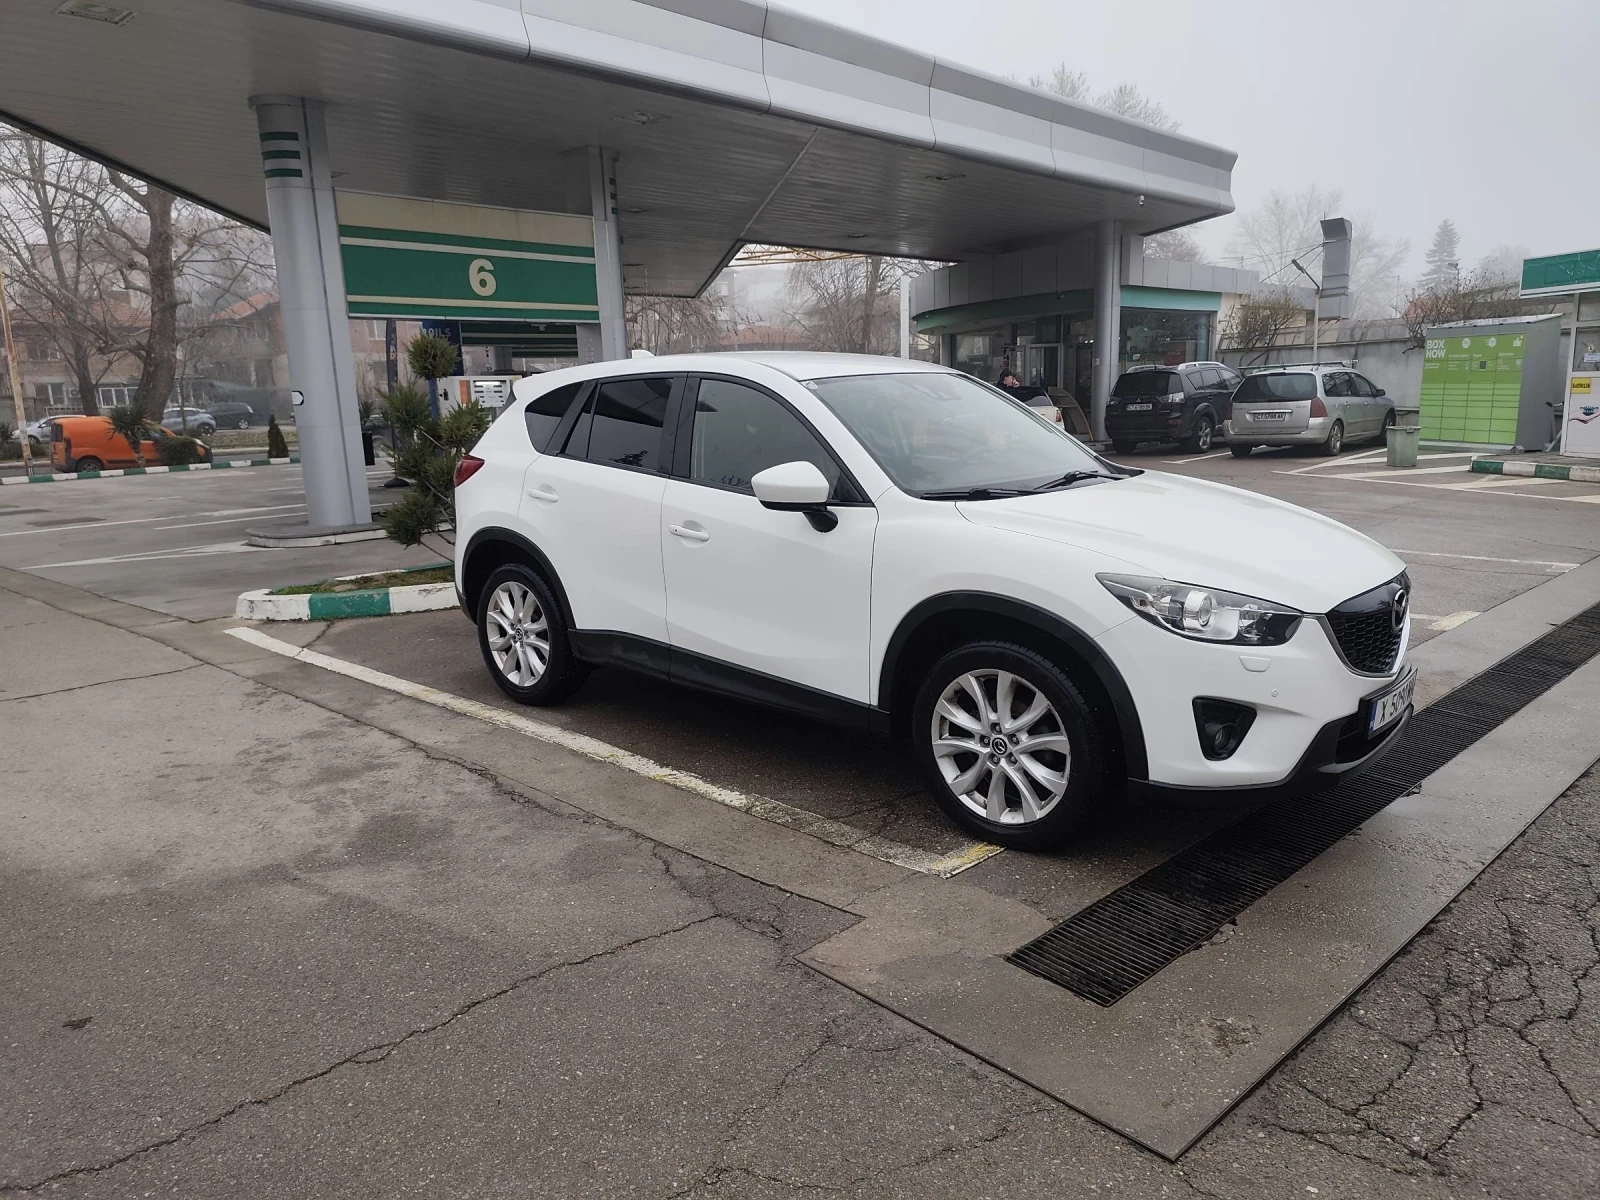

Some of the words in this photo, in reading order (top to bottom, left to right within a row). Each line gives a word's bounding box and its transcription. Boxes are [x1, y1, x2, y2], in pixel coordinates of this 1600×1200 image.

[469, 258, 496, 297] 6
[1426, 340, 1445, 349] BOX
[1425, 349, 1446, 358] NOW
